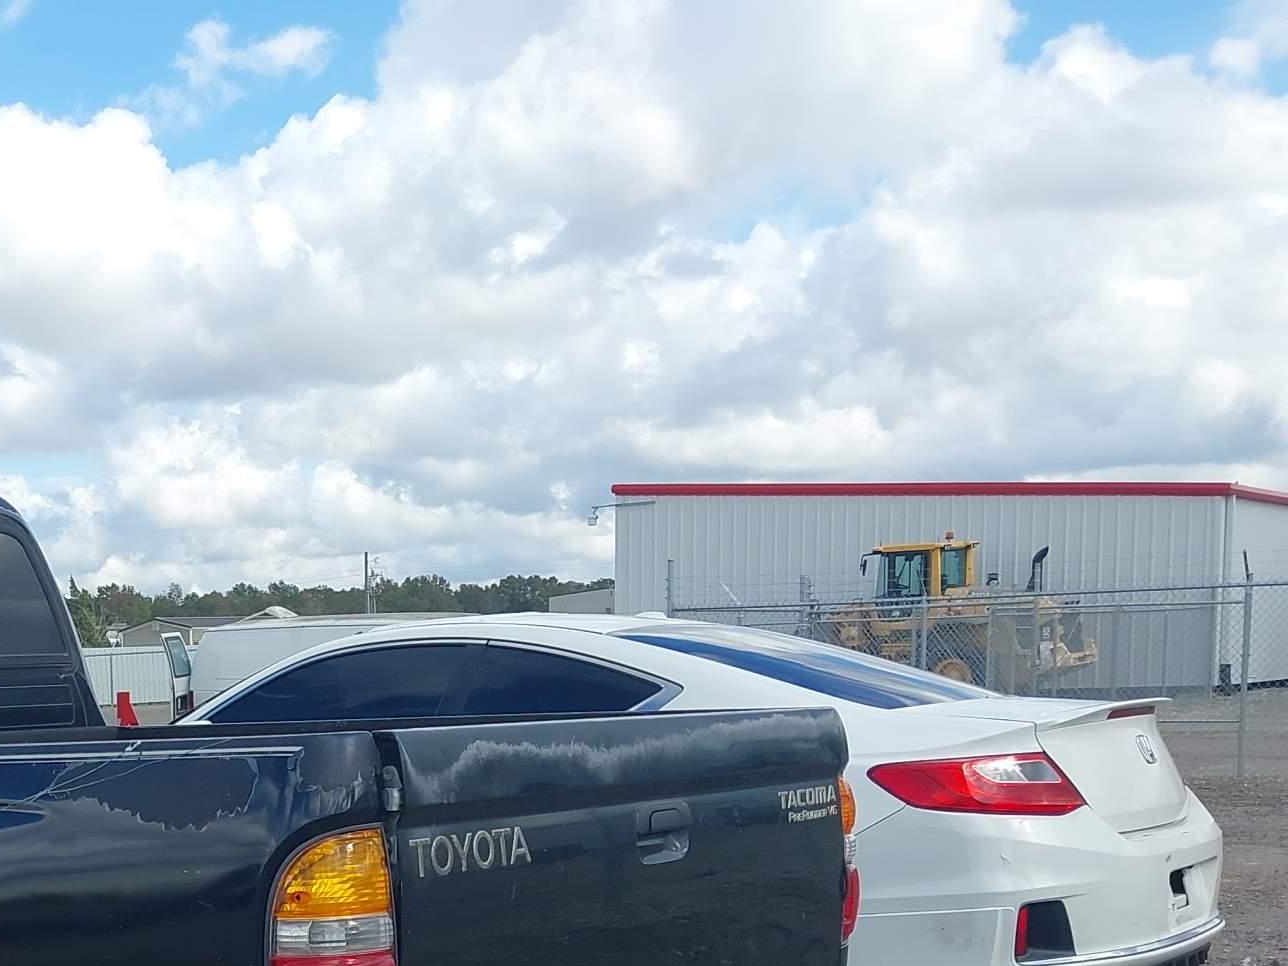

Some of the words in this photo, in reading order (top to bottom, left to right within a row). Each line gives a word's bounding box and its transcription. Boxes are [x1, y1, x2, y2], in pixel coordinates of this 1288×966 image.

[778, 785, 837, 809] TACOMA
[827, 805, 838, 816] V6
[409, 826, 532, 878] TOYOTA
